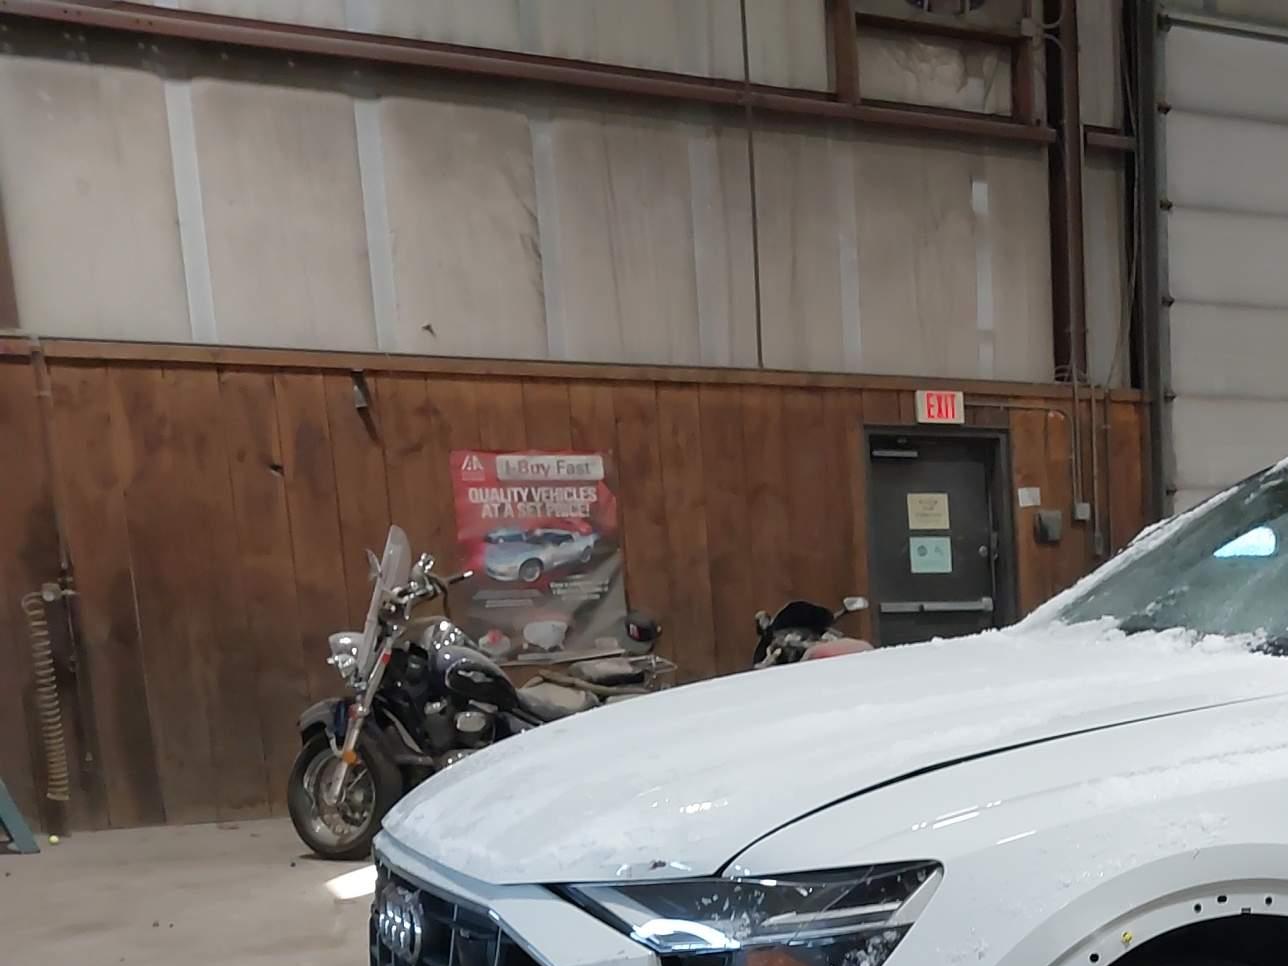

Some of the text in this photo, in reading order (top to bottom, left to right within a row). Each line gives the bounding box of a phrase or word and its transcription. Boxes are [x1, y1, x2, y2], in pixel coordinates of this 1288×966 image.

[926, 392, 956, 419] EXIT
[556, 460, 591, 475] Fast
[468, 487, 597, 503] QUALITY VEHICLES
[481, 503, 501, 518] AT
[502, 503, 514, 518] A
[516, 503, 543, 518] SET
